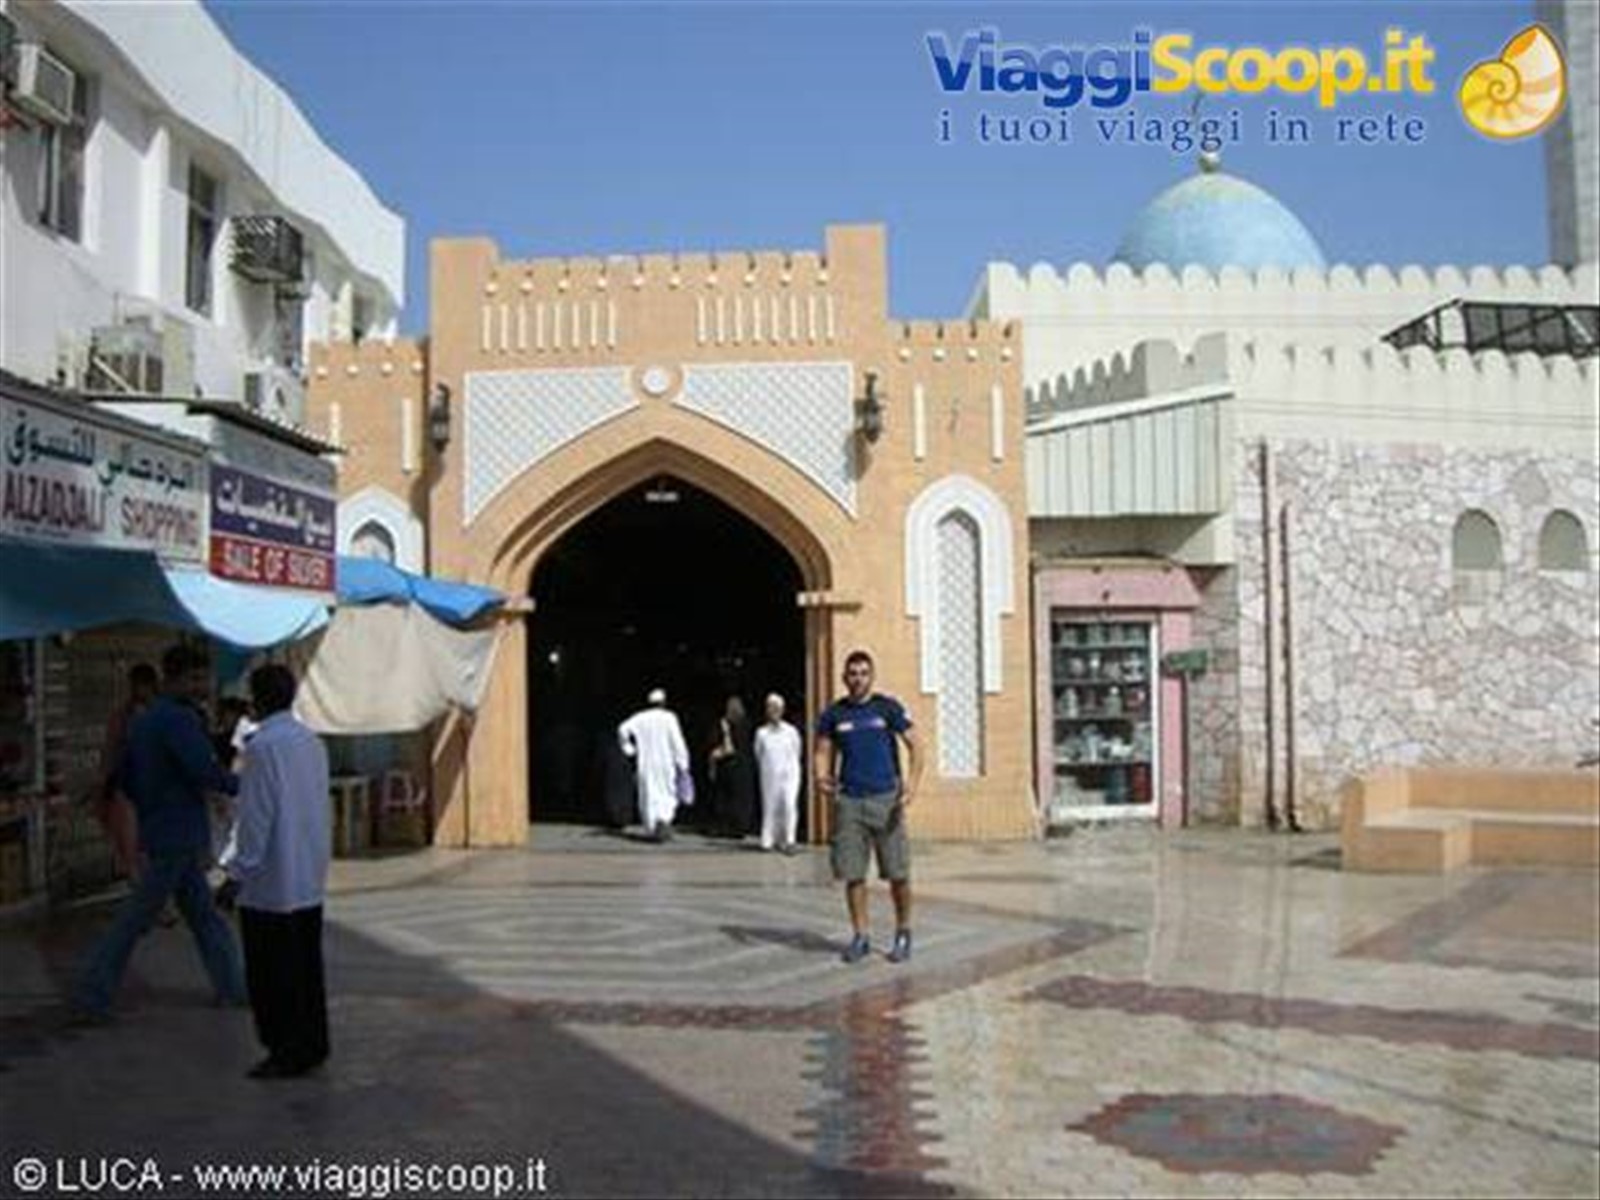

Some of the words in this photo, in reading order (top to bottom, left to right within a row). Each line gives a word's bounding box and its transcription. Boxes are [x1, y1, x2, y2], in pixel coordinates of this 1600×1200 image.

[3, 409, 96, 467] للتسوق
[121, 495, 199, 548] SHOPPING
[223, 540, 260, 579] SALE
[264, 547, 285, 581] OF
[288, 550, 328, 587] SILVER
